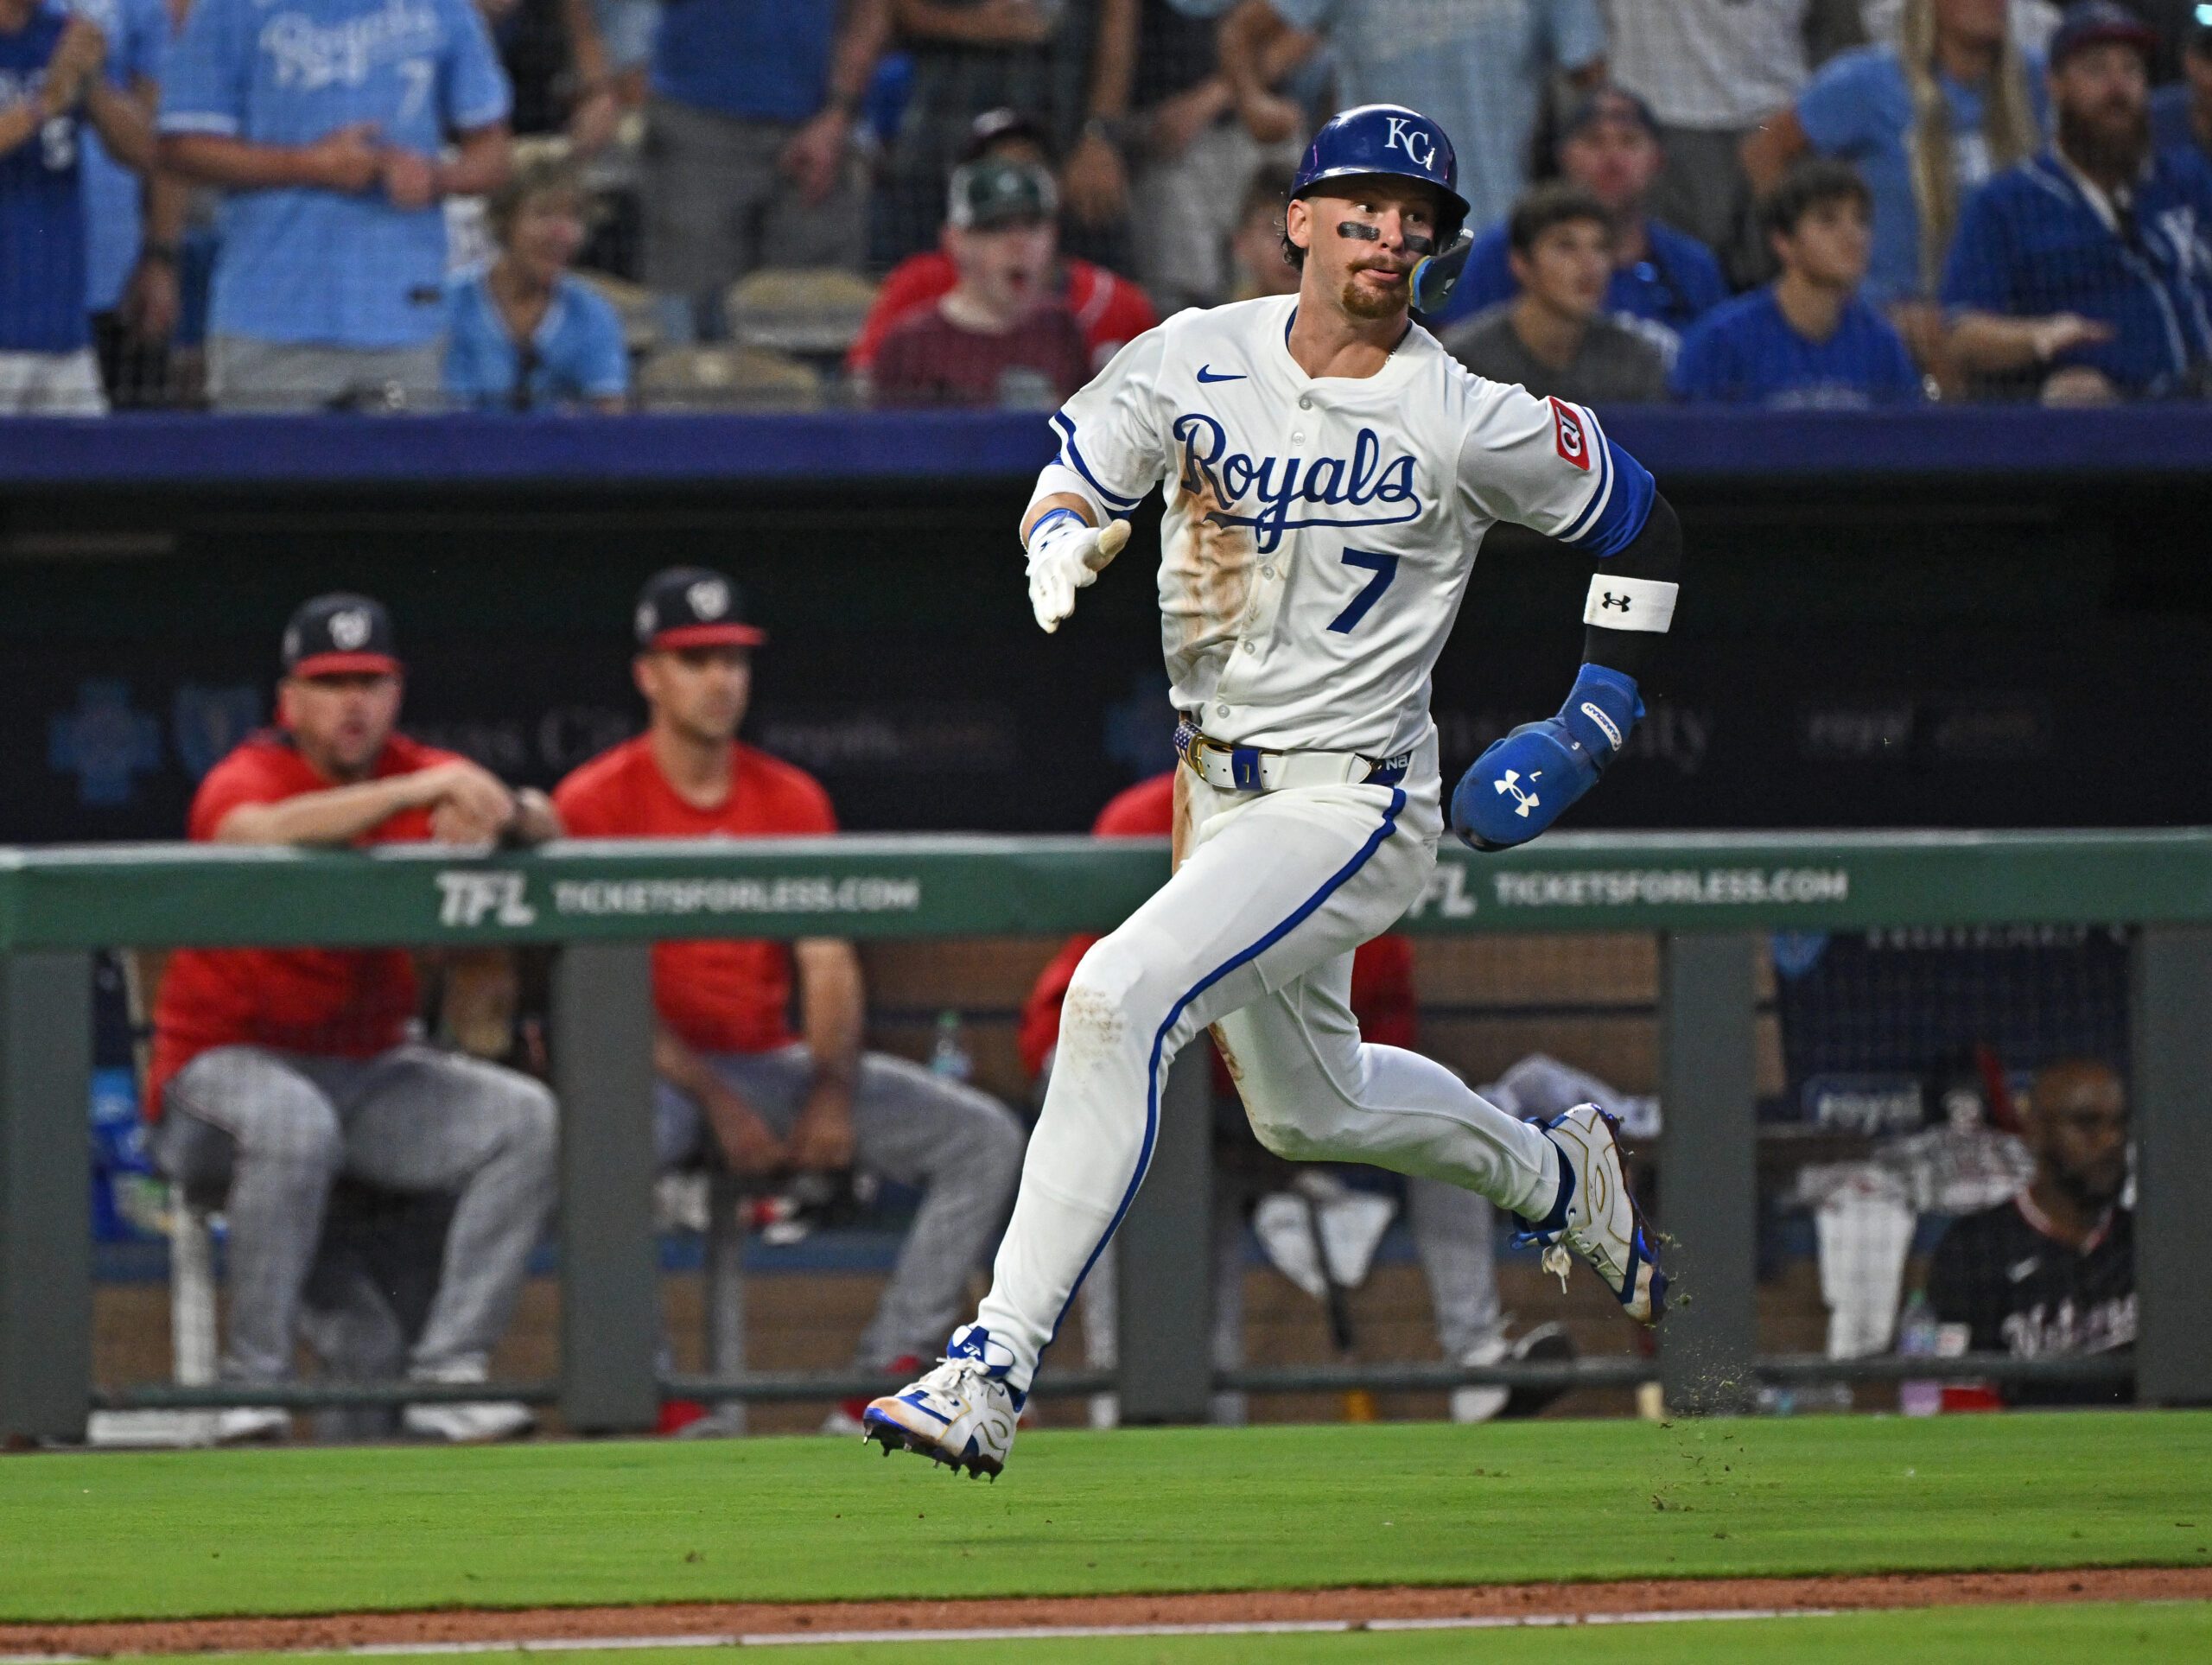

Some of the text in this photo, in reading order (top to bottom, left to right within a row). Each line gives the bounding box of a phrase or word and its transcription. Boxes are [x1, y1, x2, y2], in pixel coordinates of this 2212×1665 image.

[1384, 118, 1435, 171] KC
[1173, 414, 1422, 554] Royals
[1326, 547, 1399, 634] 7
[436, 870, 920, 926] TFL TICKETSFORLESS.COM
[1408, 864, 1848, 919] FL TICKETSFORLESS.COM
